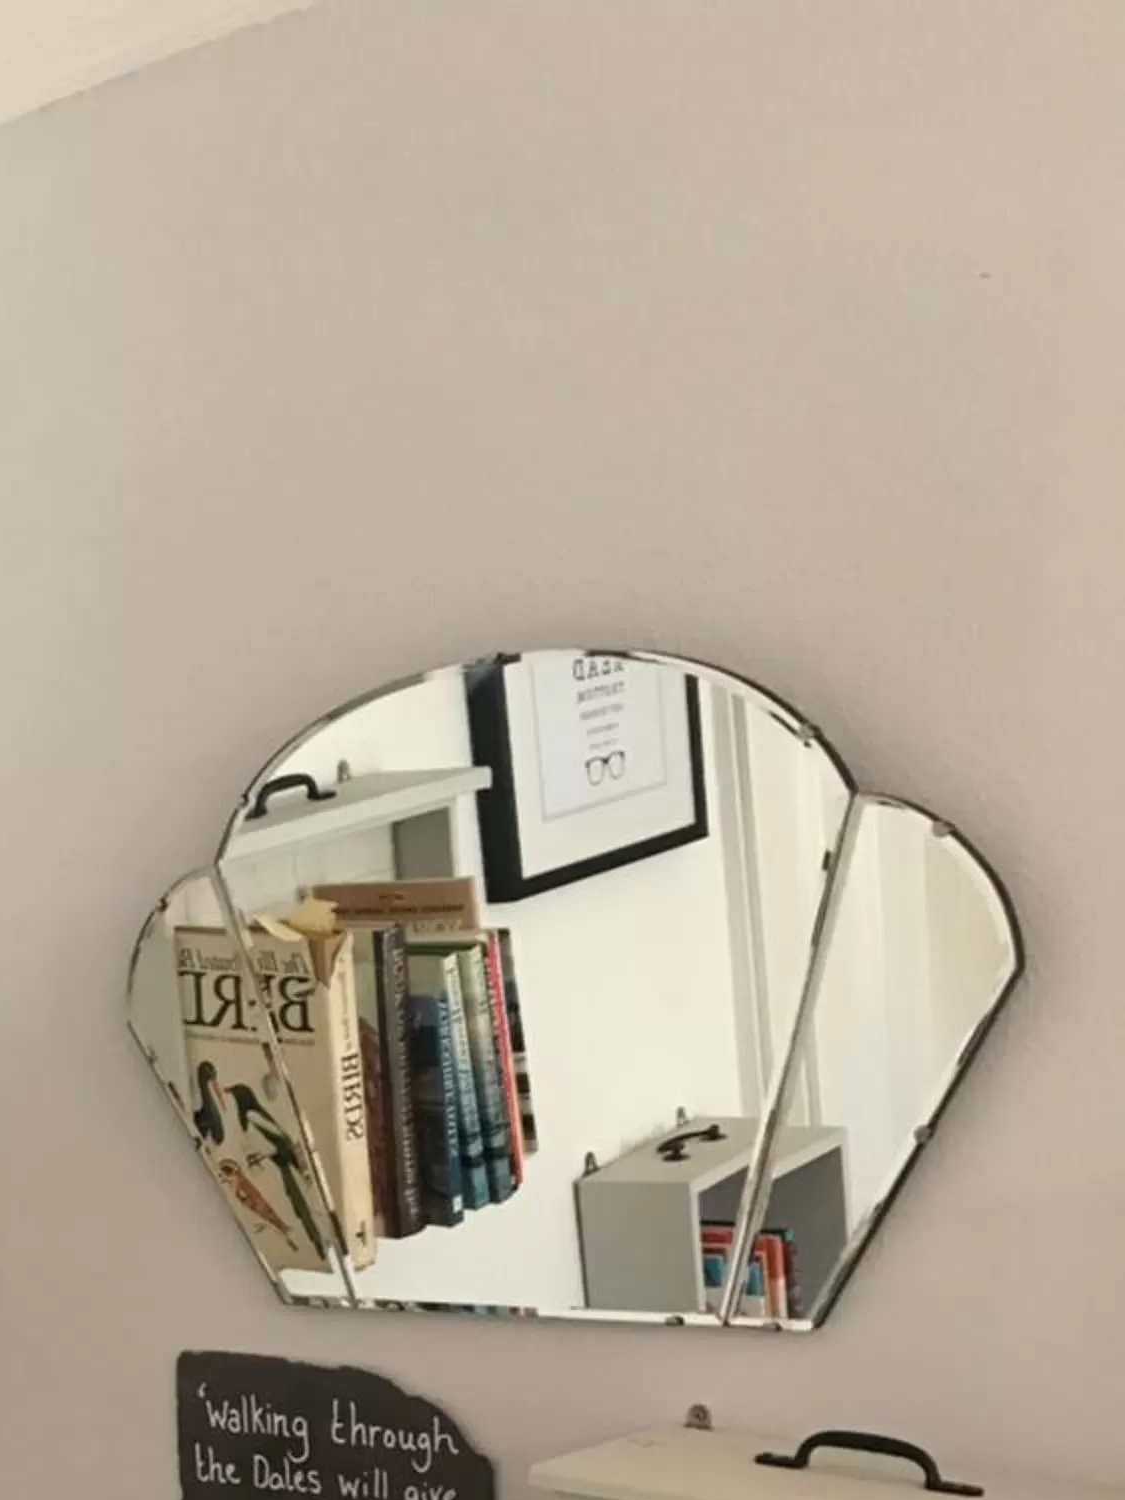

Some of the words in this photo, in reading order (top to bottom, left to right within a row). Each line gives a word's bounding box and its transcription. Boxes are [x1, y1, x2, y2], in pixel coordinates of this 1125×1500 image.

[330, 1398, 459, 1473] through
[195, 1442, 241, 1485] the
[253, 1454, 322, 1494] Dales
[337, 1467, 389, 1500] will
